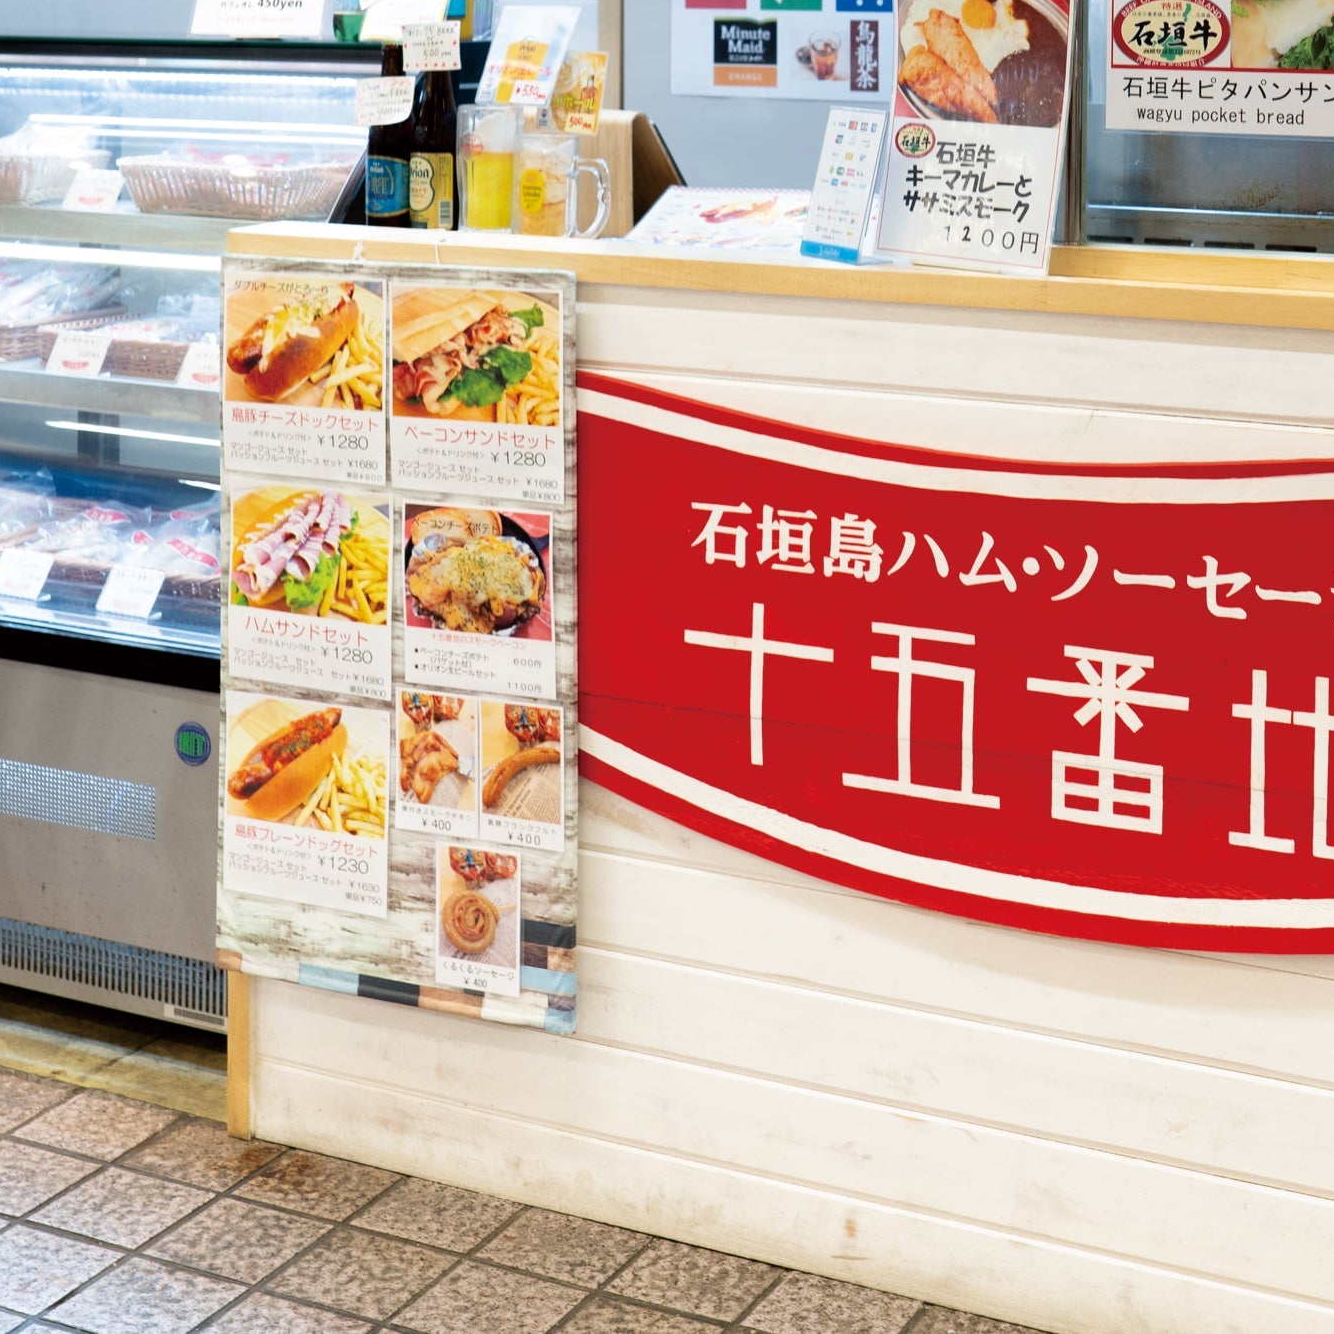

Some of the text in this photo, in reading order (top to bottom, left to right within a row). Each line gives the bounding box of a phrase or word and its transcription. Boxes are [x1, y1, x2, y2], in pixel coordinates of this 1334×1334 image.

[721, 25, 771, 41] Minute
[1128, 19, 1218, 51] 石垣牛
[728, 40, 764, 54] Maid
[1137, 105, 1305, 125] wagyu pocket bread
[936, 141, 996, 167] 石垣牛
[906, 165, 1032, 197] キーマカレーと
[903, 190, 1030, 222] ササミスモーク
[945, 226, 1040, 254] 1200円
[317, 435, 369, 451] ¥1280
[405, 425, 555, 450] ベーコンサンドセット
[491, 450, 547, 467] ¥1280
[245, 616, 368, 647] ハムサンドセット
[320, 645, 373, 664] ¥1280
[422, 818, 452, 832] ¥400
[507, 831, 541, 846] ¥400
[317, 855, 369, 875] ¥1230
[463, 976, 487, 989] ¥400
